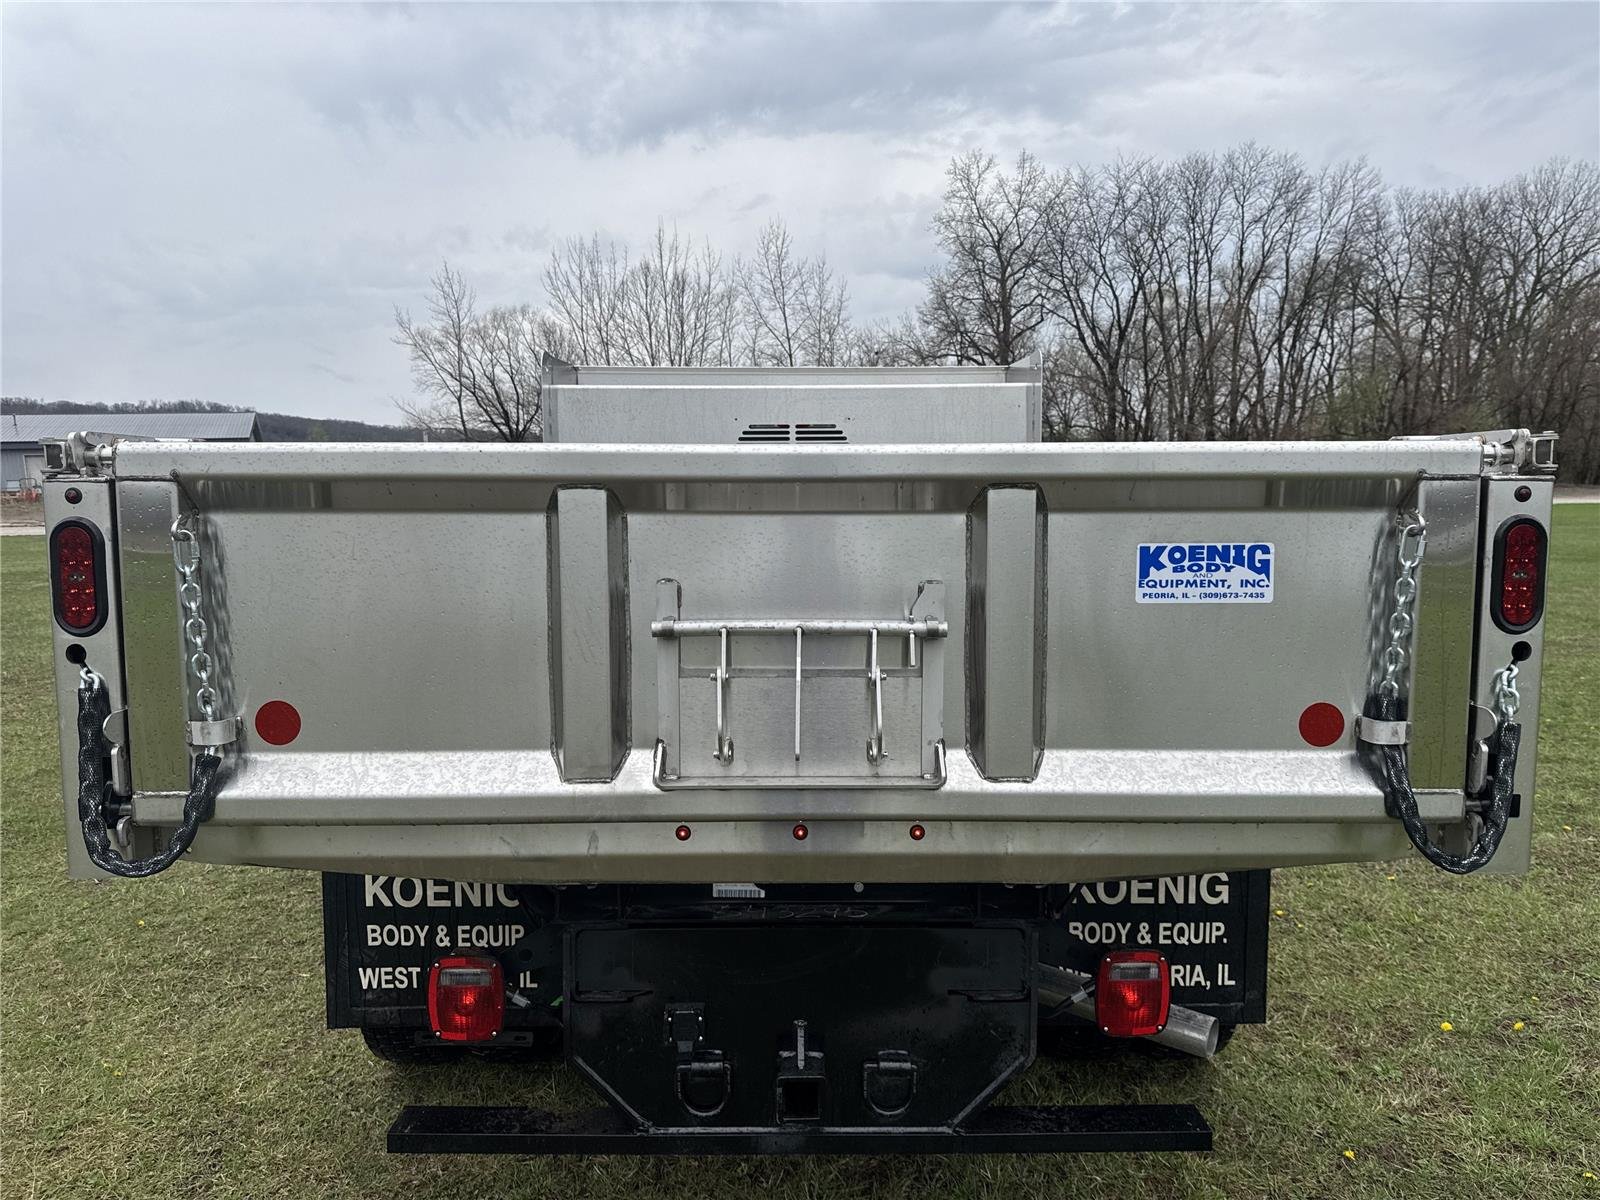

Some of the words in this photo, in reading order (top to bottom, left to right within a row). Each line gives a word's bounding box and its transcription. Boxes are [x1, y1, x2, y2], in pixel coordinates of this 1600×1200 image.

[1139, 544, 1271, 583] KOENIG
[1172, 563, 1236, 573] BODY
[1138, 578, 1232, 590] EQUIPMENT,
[1240, 578, 1270, 588] INC.
[1142, 592, 1179, 600] PEORIA,
[1199, 592, 1265, 600] (309)673-7435
[366, 924, 429, 947] BODY
[435, 924, 451, 947] &
[1069, 921, 1131, 945] BODY
[1137, 921, 1152, 944] &
[1158, 921, 1228, 945] EQUIP.
[358, 966, 421, 990] WEST
[519, 970, 539, 989] IL
[1171, 963, 1211, 990] RIA,
[1217, 962, 1236, 986] IL
